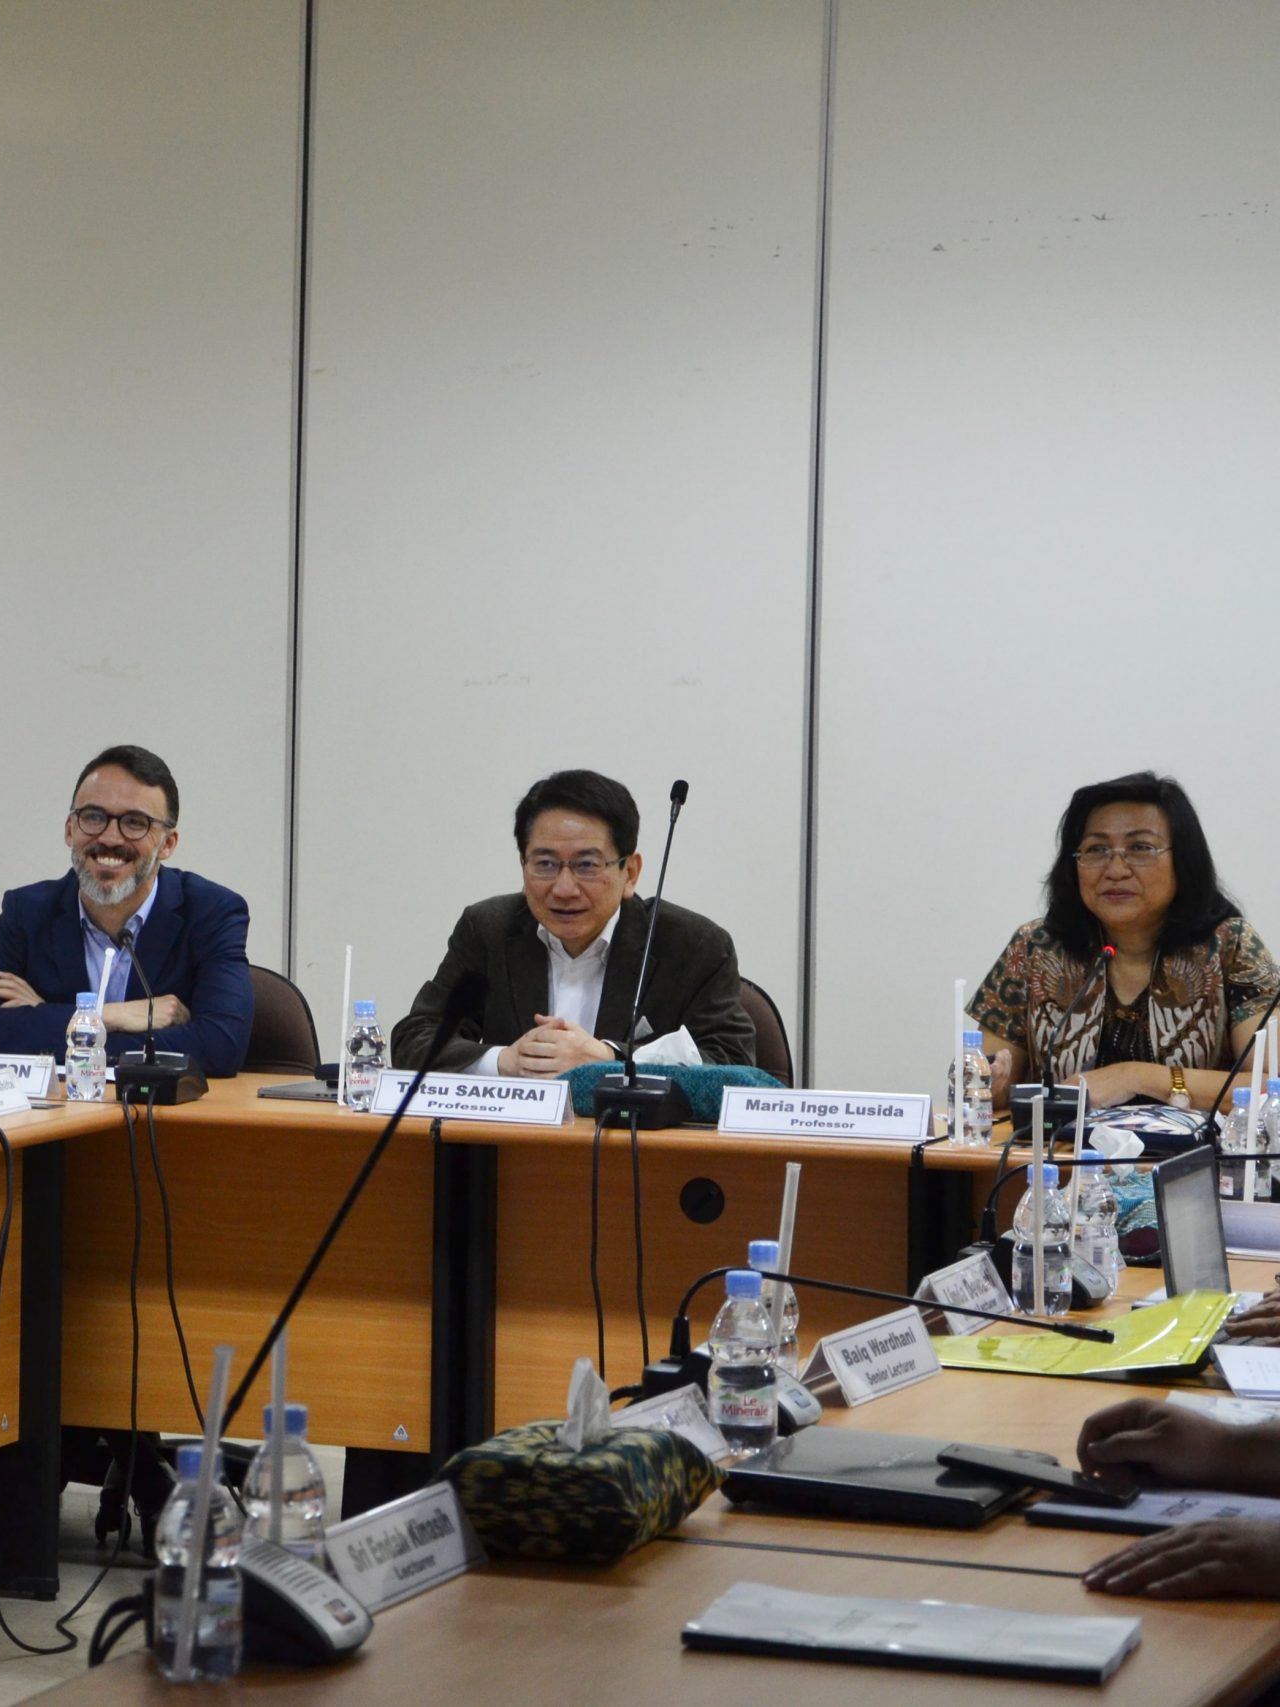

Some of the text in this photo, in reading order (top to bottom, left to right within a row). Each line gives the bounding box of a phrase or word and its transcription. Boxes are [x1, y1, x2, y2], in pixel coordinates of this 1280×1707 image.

[397, 1081, 545, 1102] Ttsu SAKURAI
[427, 1100, 505, 1113] Professor
[745, 1099, 904, 1118] Maria Inge Lusida
[790, 1118, 856, 1130] Professor
[841, 1326, 917, 1367] Baiq Wardhani
[865, 1359, 917, 1386] Senior Lecturer
[743, 1394, 758, 1406] Le
[393, 1554, 437, 1581] Lecturer
